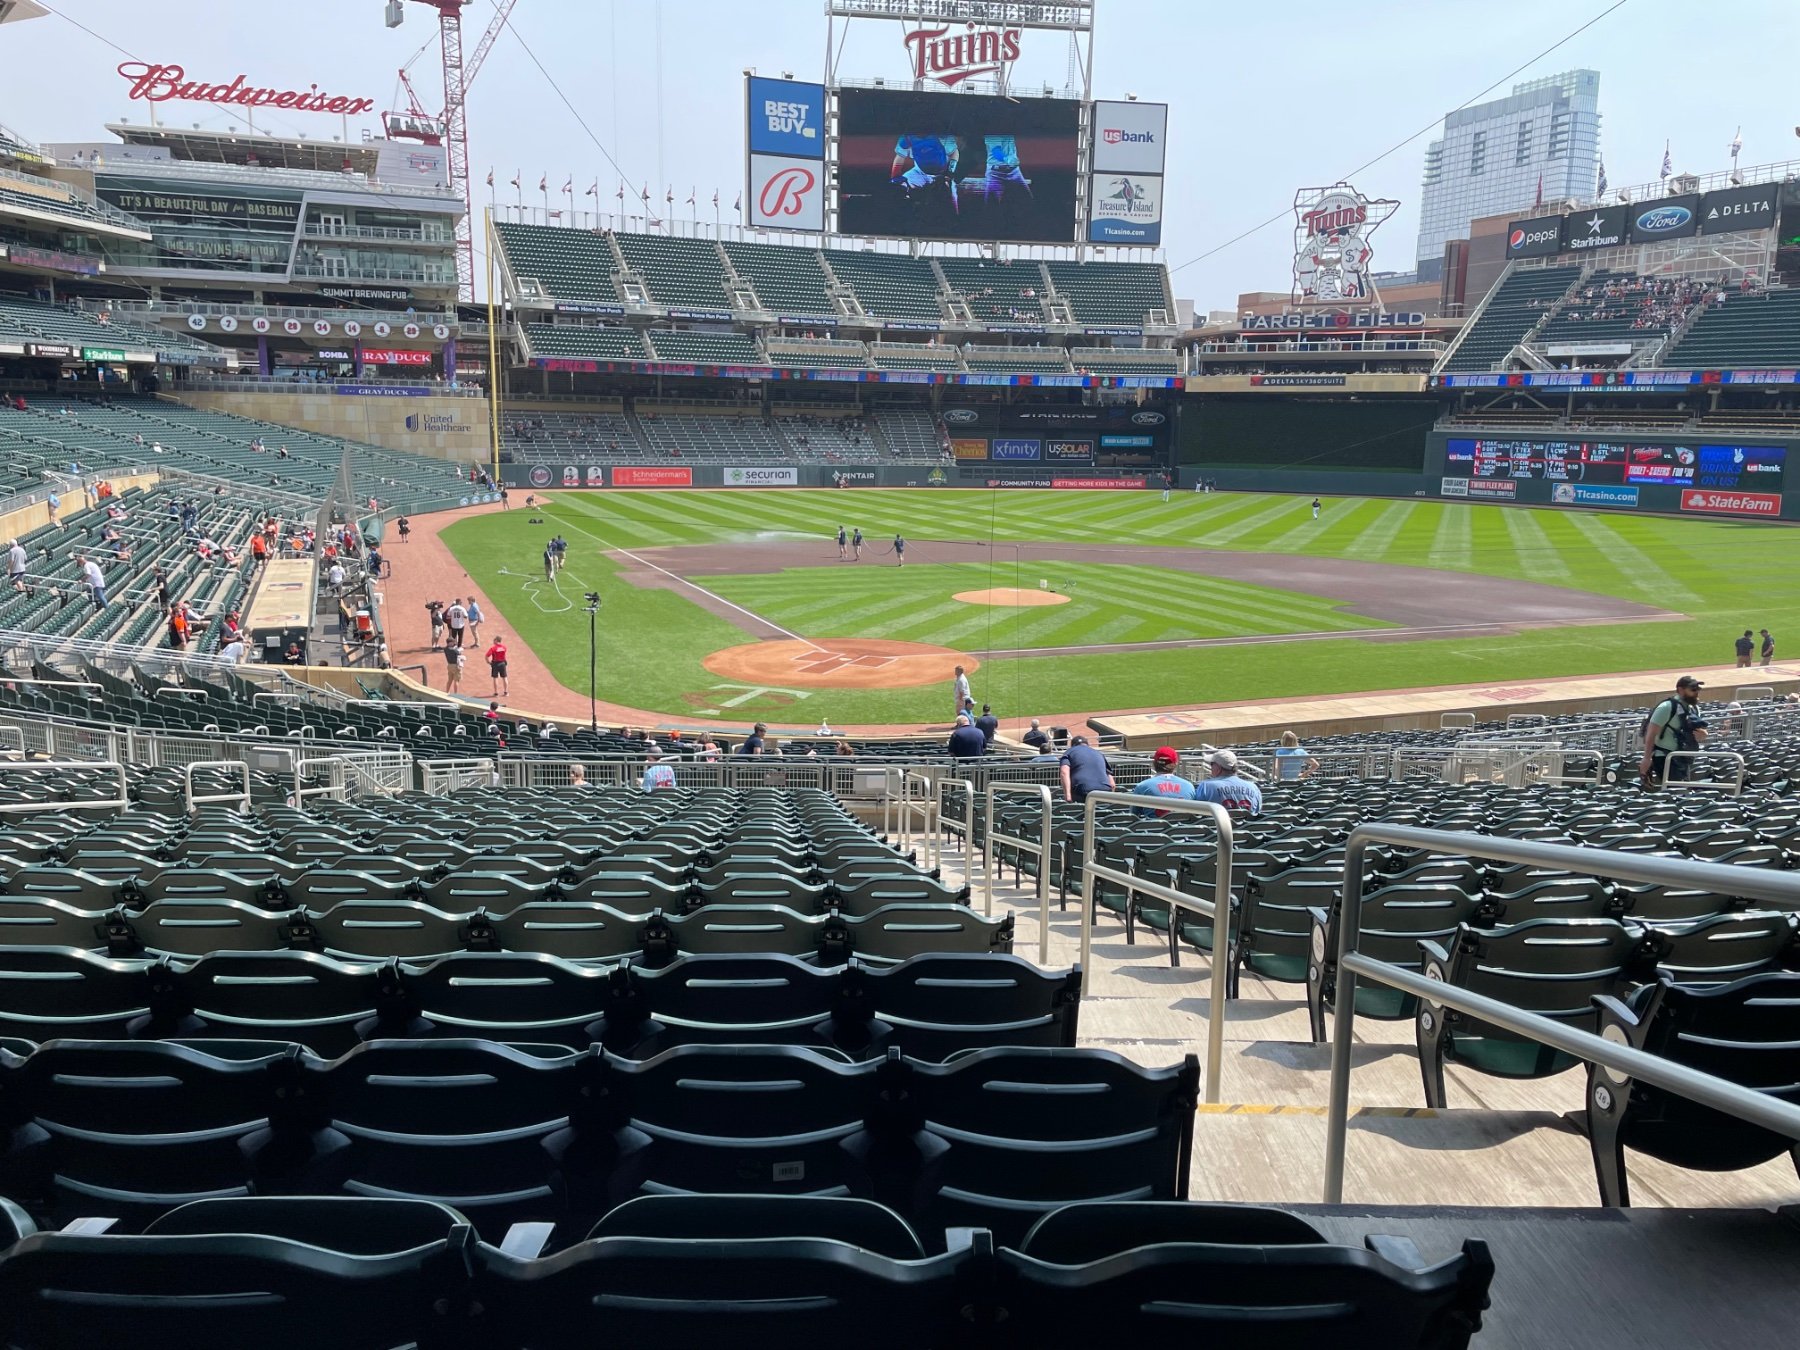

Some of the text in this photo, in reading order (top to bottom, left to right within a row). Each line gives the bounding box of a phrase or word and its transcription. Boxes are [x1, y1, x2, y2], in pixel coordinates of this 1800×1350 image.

[904, 21, 1021, 87] Twins
[118, 62, 374, 115] Budweiser
[765, 100, 809, 119] BEST
[768, 116, 805, 134] BUY
[119, 195, 142, 207] IT'S
[144, 197, 151, 208] A
[154, 196, 209, 212] BEAUTIFUL
[211, 201, 228, 213] DAY
[248, 203, 295, 217] BASEBALL
[1098, 199, 1154, 213] Treasure Island
[1722, 201, 1770, 216] DELTA
[1302, 204, 1367, 238] Twins
[1647, 211, 1681, 227] Ford
[1526, 227, 1558, 246] pepsi
[1570, 234, 1619, 249] StarTribune
[198, 240, 232, 257] TWINS
[323, 287, 407, 299] SUMMIT BREWING PUB
[225, 320, 232, 328] 7
[257, 321, 266, 329] 10
[348, 324, 356, 333] 14
[1243, 312, 1425, 330] TARGET FIELD
[318, 351, 349, 359] BOMBA
[394, 353, 432, 362] DUCK
[423, 414, 453, 424] United
[950, 412, 972, 421] Ford
[1138, 414, 1159, 423] Ford
[424, 423, 472, 433] Healthcare
[996, 441, 1038, 457] xfinity
[632, 470, 688, 478] Schneiderman's
[745, 469, 791, 479] securian
[1700, 464, 1742, 474] DRINKS
[842, 472, 875, 480] PINTAIR
[1701, 476, 1718, 486] ON
[1719, 477, 1738, 487] US!
[1576, 489, 1637, 501] TIcasino.com
[1157, 781, 1181, 794] RYAN
[1217, 785, 1255, 799] MORNEAU
